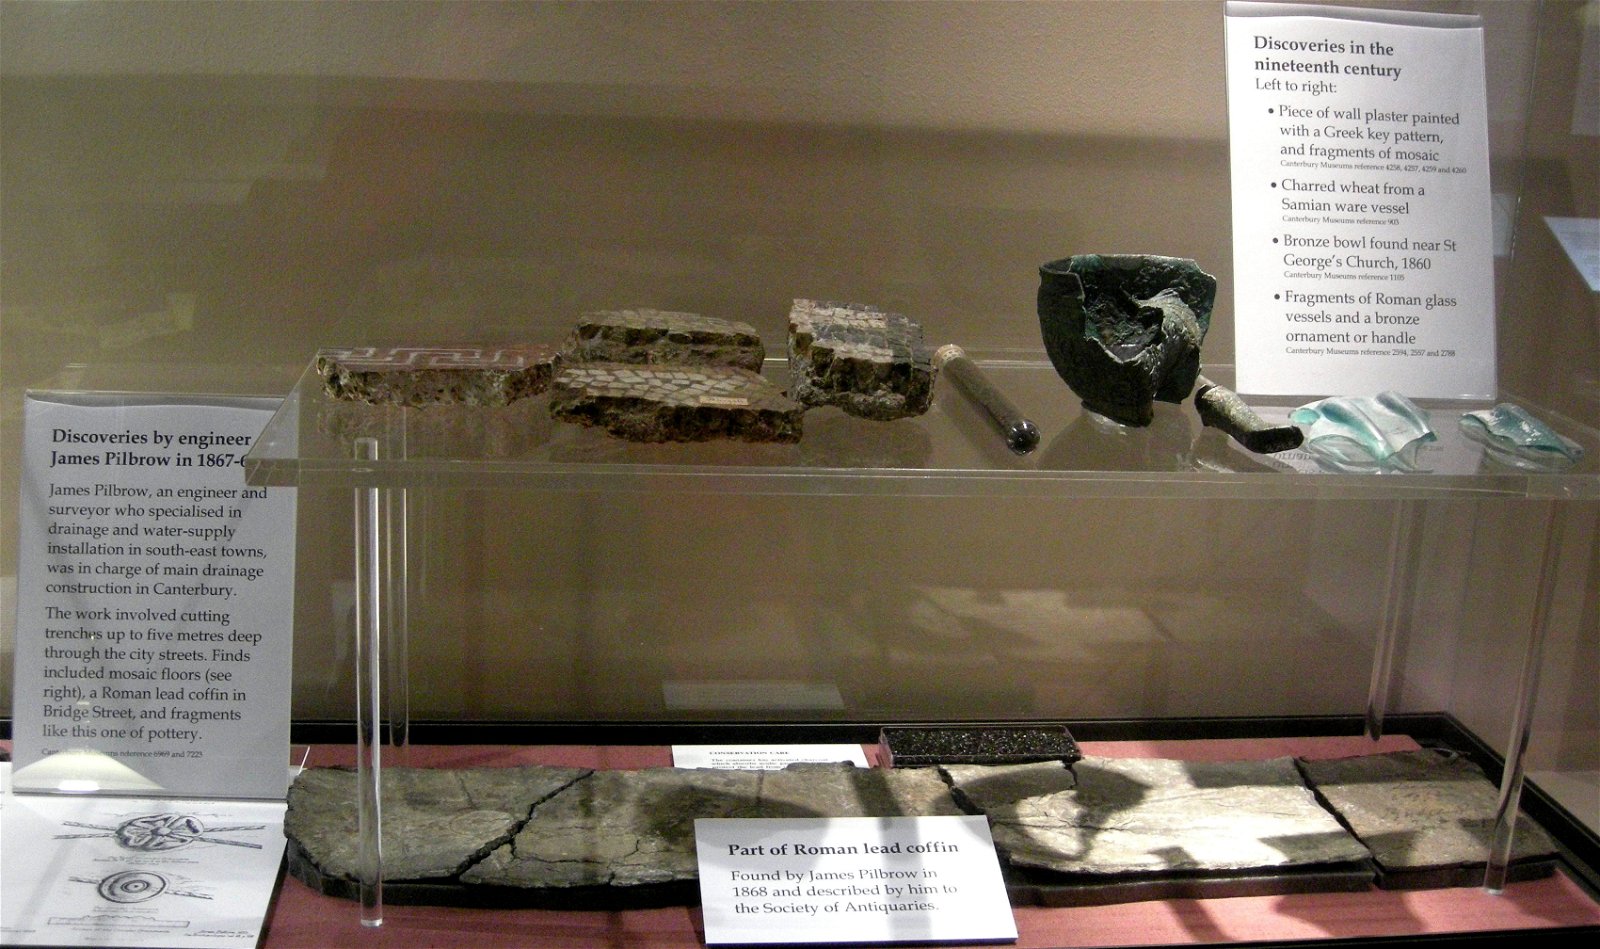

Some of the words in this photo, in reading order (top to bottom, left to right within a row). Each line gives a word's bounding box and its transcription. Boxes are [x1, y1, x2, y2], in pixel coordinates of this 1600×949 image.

[1254, 36, 1345, 53] Discoveries
[1350, 40, 1365, 54] in
[1369, 41, 1394, 56] the
[1254, 57, 1340, 73] nineteenth
[1343, 64, 1402, 81] century
[1255, 78, 1281, 90] Left
[1285, 80, 1298, 91] to
[1302, 80, 1337, 96] right:
[1279, 104, 1313, 118] Piece
[1316, 106, 1330, 118] of
[1333, 107, 1361, 120] wall
[1364, 108, 1408, 124] plaster
[1411, 112, 1460, 126] painted
[1280, 124, 1310, 136] with
[1313, 128, 1321, 137] a
[1323, 125, 1364, 139] Greek
[1367, 127, 1390, 144] key
[1394, 131, 1443, 144] pattern,
[1280, 143, 1305, 156] and
[1309, 144, 1375, 160] fragments
[1378, 146, 1392, 160] of
[1395, 150, 1439, 161] mosaic
[1280, 159, 1319, 169] Canterbury
[1320, 161, 1353, 169] Museums
[1281, 178, 1336, 192] Charred
[1340, 181, 1380, 194] wheat
[1383, 182, 1415, 195] from
[1417, 187, 1425, 196] a
[1281, 198, 1331, 211] Samian
[1334, 203, 1368, 212] ware
[1370, 202, 1409, 214] vessel
[1282, 215, 1321, 224] Canterbury
[1322, 216, 1355, 224] Museums
[1356, 217, 1387, 225] reference
[1283, 234, 1330, 247] Bronze
[1333, 235, 1366, 248] bowl
[1370, 236, 1409, 250] found
[1412, 241, 1441, 251] near
[1443, 239, 1456, 251] St
[1283, 253, 1343, 272] George's
[1345, 255, 1398, 270] Church,
[1401, 257, 1431, 269] 1860
[1283, 270, 1322, 280] Canterbury
[1285, 290, 1355, 307] Fragments
[1358, 291, 1372, 304] of
[1375, 292, 1422, 305] Roman
[1425, 294, 1457, 310] glass
[1285, 310, 1332, 323] vessels
[1334, 311, 1360, 323] and
[1363, 314, 1371, 324] a
[1374, 311, 1420, 325] bronze
[1285, 332, 1350, 342] ornament
[1353, 334, 1368, 343] or
[1371, 330, 1416, 344] handle
[1285, 346, 1325, 356] Canterbury
[1326, 347, 1360, 355] Museums
[1360, 348, 1391, 356] reference
[52, 428, 148, 444] Discoveries
[153, 430, 174, 449] by
[178, 431, 252, 449] engineer
[49, 450, 100, 467] James
[104, 451, 171, 466] Pilbrow
[175, 452, 192, 466] in
[48, 483, 90, 497] James
[94, 484, 152, 498] Pilbrow,
[156, 488, 173, 497] an
[176, 486, 238, 502] engineer
[241, 485, 267, 499] and
[48, 506, 111, 519] surveyor
[114, 503, 145, 516] who
[148, 505, 224, 520] specialised
[228, 506, 242, 518] in
[47, 522, 109, 539] drainage
[112, 523, 138, 536] and
[143, 525, 236, 541] water-supply
[47, 542, 124, 555] installation
[128, 543, 142, 555] in
[145, 543, 218, 557] south-east
[220, 545, 267, 558] towns,
[46, 564, 74, 574] was
[78, 561, 91, 574] in
[94, 561, 142, 579] charge
[145, 562, 160, 575] of
[163, 563, 199, 576] main
[202, 563, 264, 581] drainage
[45, 582, 132, 594] construction
[135, 582, 150, 594] in
[152, 582, 237, 600] Canterbury.
[44, 606, 72, 619] The
[75, 607, 112, 620] work
[115, 608, 177, 621] involved
[180, 610, 230, 626] cutting
[44, 627, 103, 640] trenches
[106, 631, 126, 644] up
[129, 629, 143, 640] to
[146, 627, 173, 640] five
[176, 630, 224, 642] metres
[227, 629, 262, 646] deep
[44, 646, 100, 663] through
[103, 646, 126, 659] the
[129, 648, 155, 664] city
[158, 649, 208, 661] streets.
[211, 648, 251, 662] Finds
[43, 665, 105, 679] included
[108, 668, 157, 680] mosaic
[160, 667, 202, 681] floors
[204, 668, 232, 684] (see
[43, 685, 86, 702] right),
[89, 689, 97, 699] a
[102, 686, 151, 699] Roman
[155, 686, 184, 700] lead
[188, 687, 228, 700] coffin
[232, 688, 246, 701] in
[43, 704, 89, 722] Bridge
[91, 705, 136, 720] Street,
[139, 706, 166, 719] and
[170, 706, 241, 724] fragments
[42, 724, 68, 737] like
[71, 724, 97, 738] this
[100, 728, 128, 738] one
[129, 725, 144, 738] of
[147, 728, 202, 743] pottery.
[728, 844, 764, 855] Part
[769, 843, 788, 855] of
[794, 844, 858, 855] Roman
[863, 842, 902, 854] lead
[906, 841, 958, 853] coffin
[731, 870, 781, 880] Found
[784, 869, 804, 883] by
[809, 870, 854, 882] James
[859, 868, 918, 879] Pilbrow
[922, 868, 937, 878] in
[732, 886, 768, 897] 1868
[772, 886, 801, 897] and
[806, 884, 880, 896] described
[884, 884, 904, 898] by
[907, 883, 938, 895] him
[942, 885, 957, 893] to
[735, 902, 759, 914] the
[762, 902, 818, 916] Society
[823, 901, 839, 912] of
[845, 898, 940, 914] Antiquaries.
